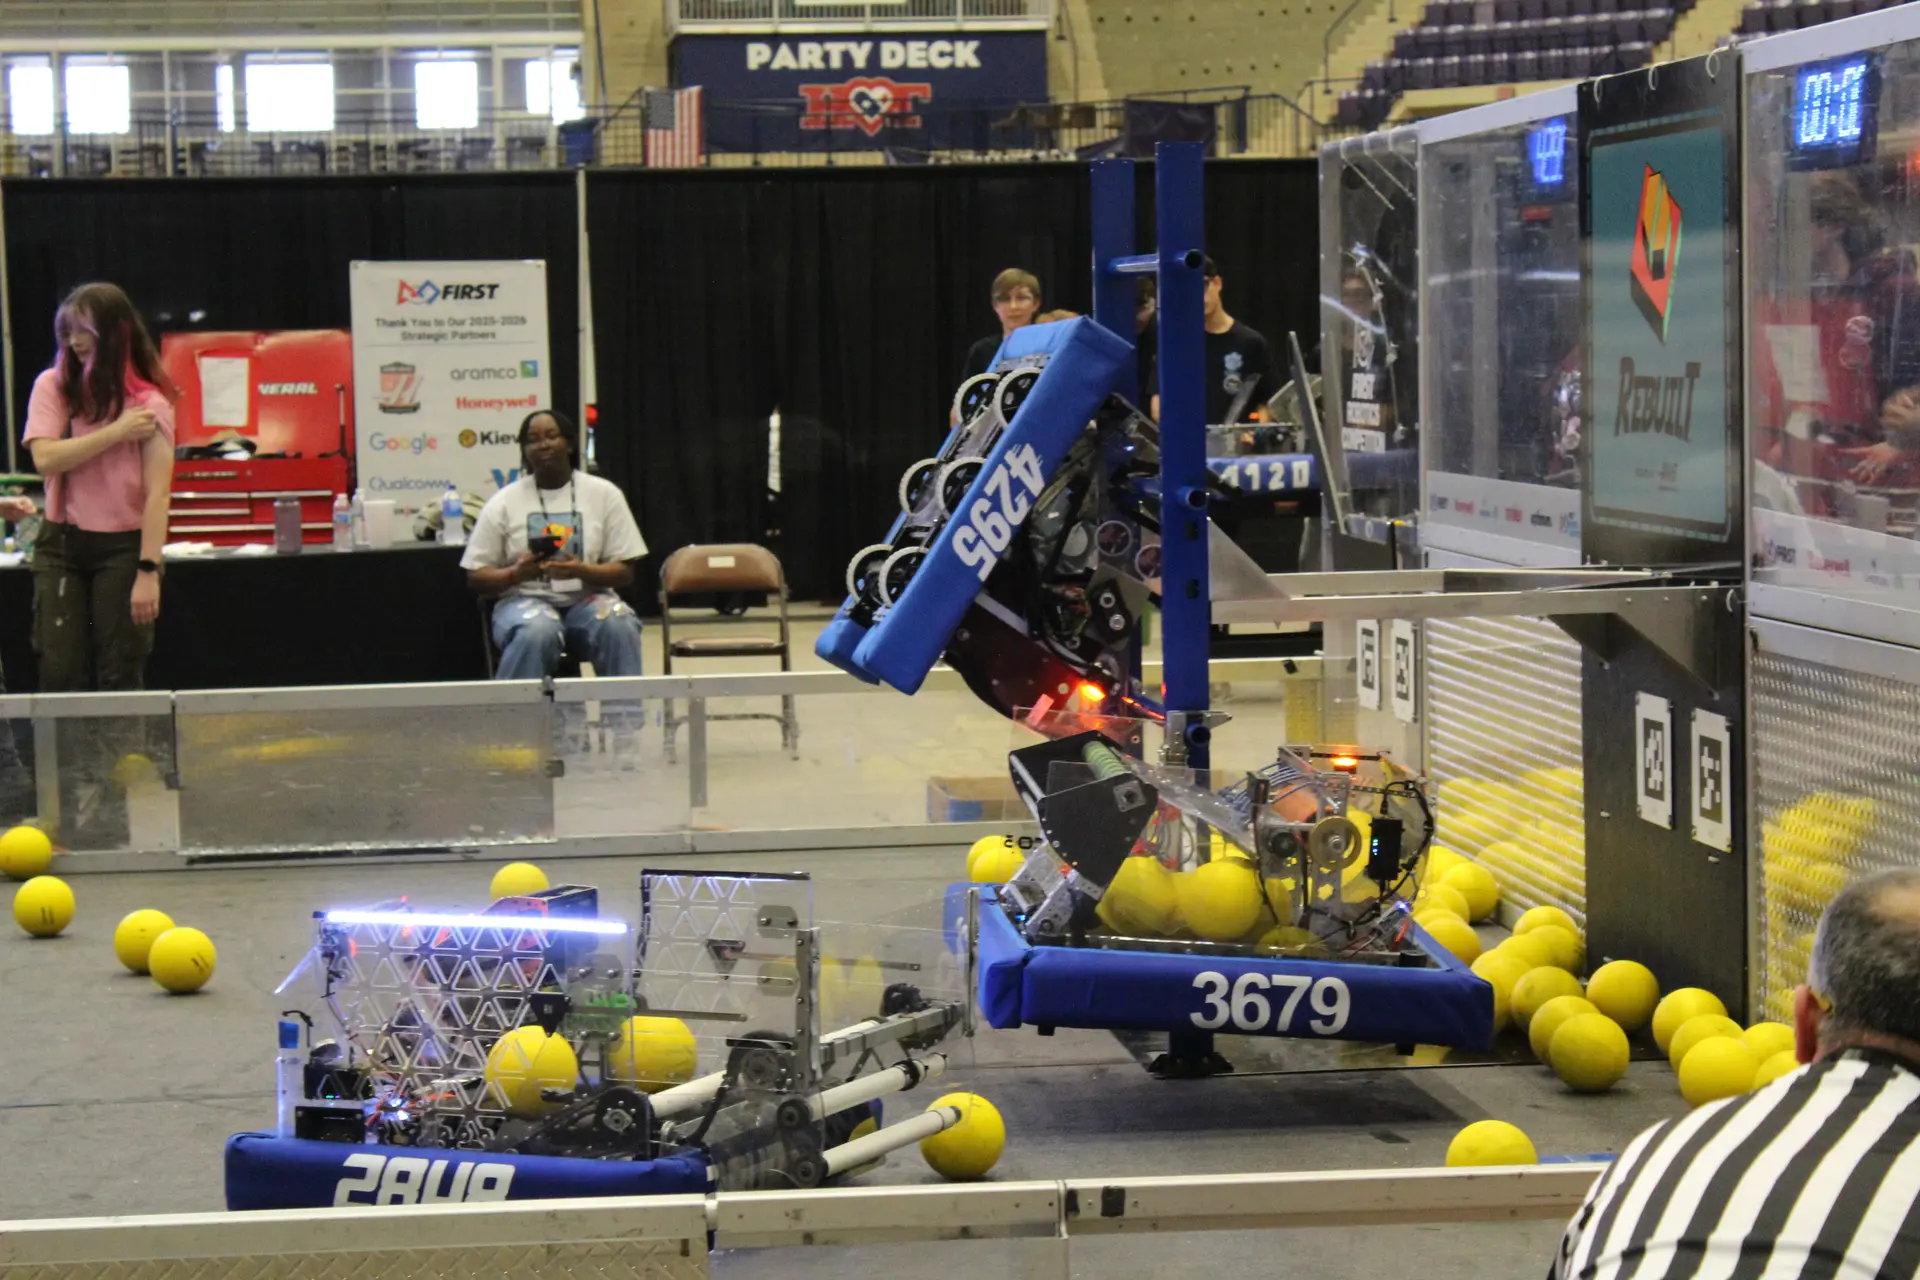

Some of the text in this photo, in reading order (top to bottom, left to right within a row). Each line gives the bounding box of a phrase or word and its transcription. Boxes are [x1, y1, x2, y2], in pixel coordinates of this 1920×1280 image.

[747, 40, 981, 70] PARTY DECK
[441, 284, 500, 300] FIRST
[375, 316, 527, 328] Thank You to Our 2025-2026
[401, 330, 496, 343] Strategic Partners
[451, 368, 517, 381] aramco
[456, 395, 538, 411] Honeywell
[369, 432, 438, 455] Google
[369, 476, 451, 491] Qualcomm
[951, 443, 1045, 582] 4295
[1190, 971, 1350, 1035] 3679
